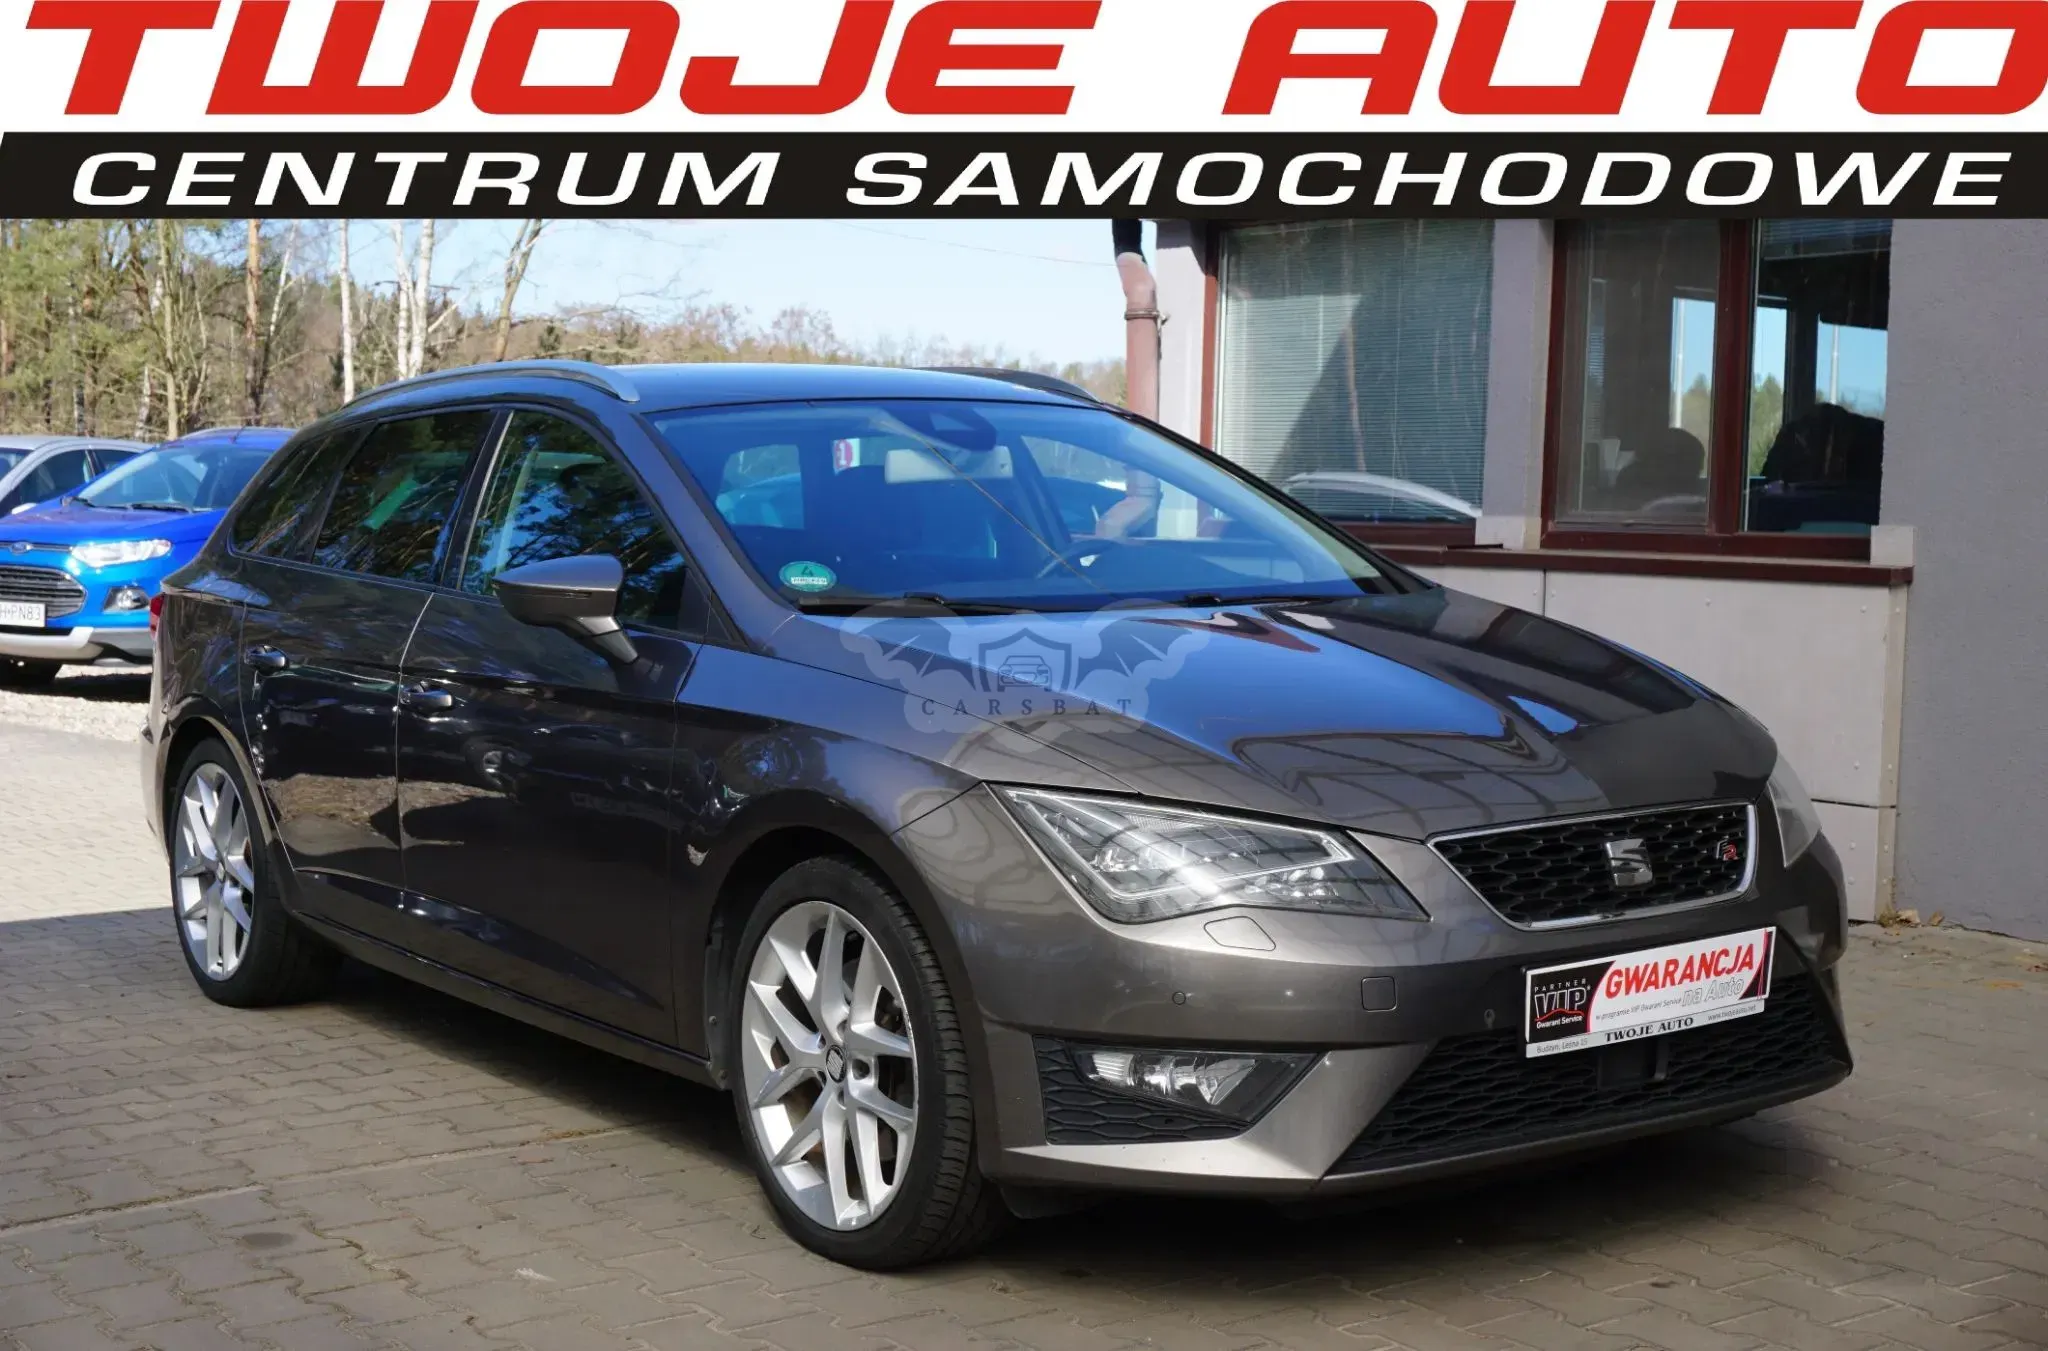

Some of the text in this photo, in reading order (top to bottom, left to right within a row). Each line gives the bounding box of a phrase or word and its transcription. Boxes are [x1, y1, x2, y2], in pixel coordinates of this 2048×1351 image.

[1605, 943, 1754, 999] GWARANCJA
[1534, 978, 1587, 992] PARTNER
[1681, 976, 1745, 1007] na Auto
[1536, 1014, 1583, 1029] Gwarant Service
[1605, 1016, 1694, 1043] TWOJE AUTO
